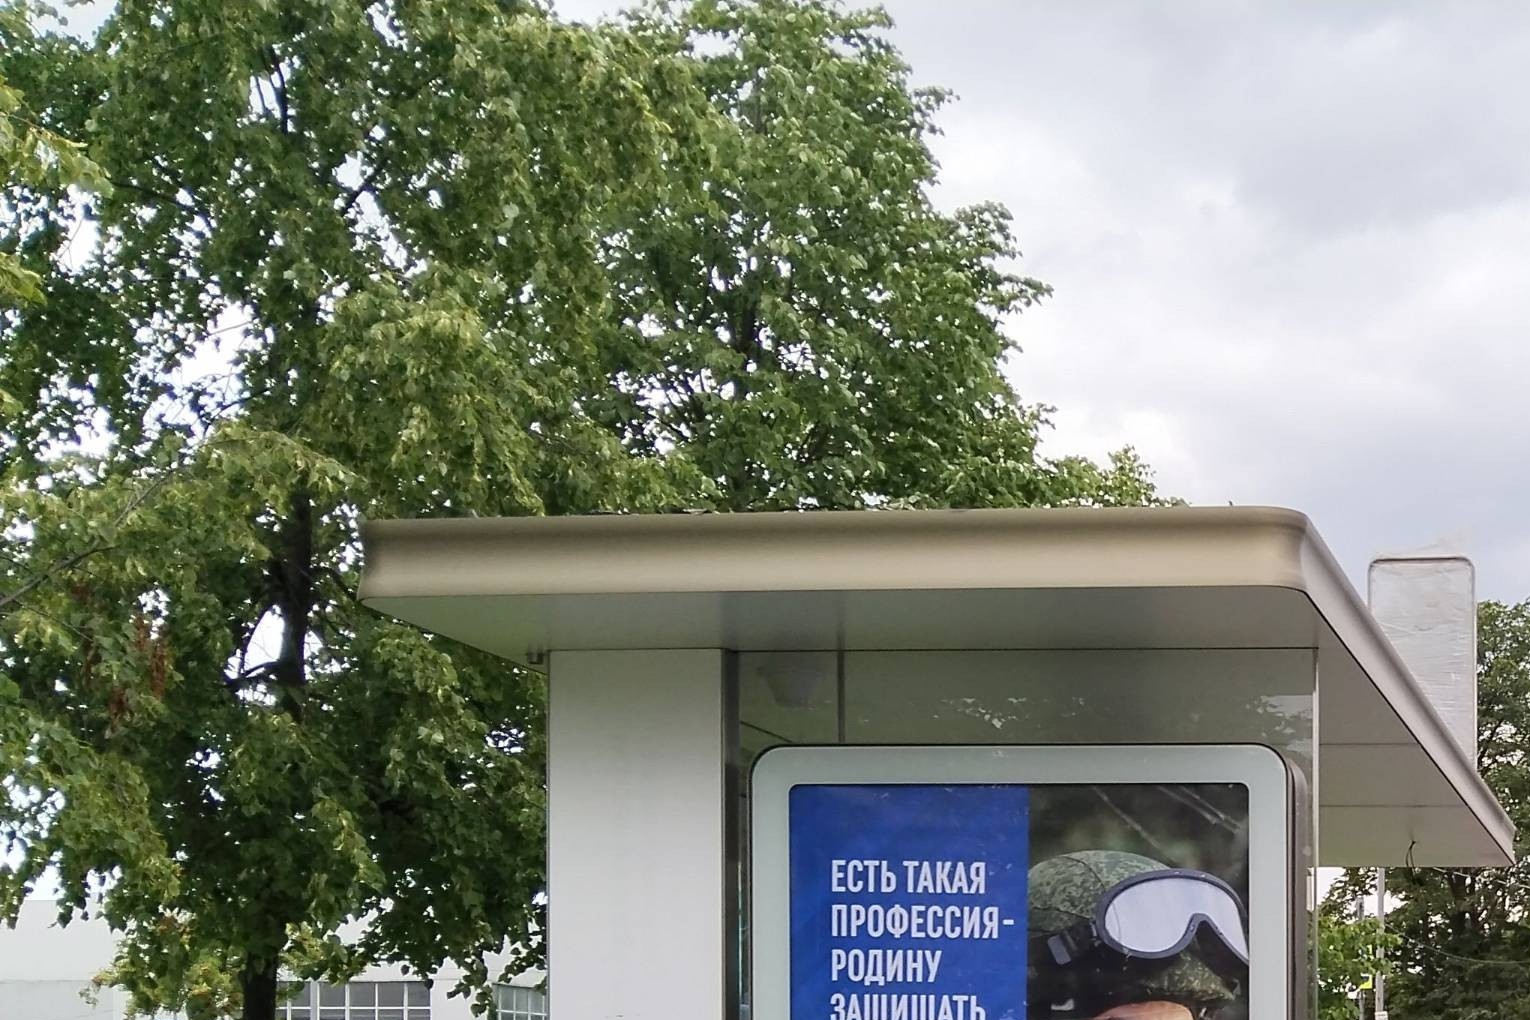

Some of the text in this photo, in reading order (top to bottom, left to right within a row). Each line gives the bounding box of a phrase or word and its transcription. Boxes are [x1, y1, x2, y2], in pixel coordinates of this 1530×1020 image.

[831, 860, 986, 893] ЕСТЬ ТАКАЯ
[831, 903, 1015, 939] ПРОФЕССИЯ-
[831, 949, 942, 985] РОДИНУ
